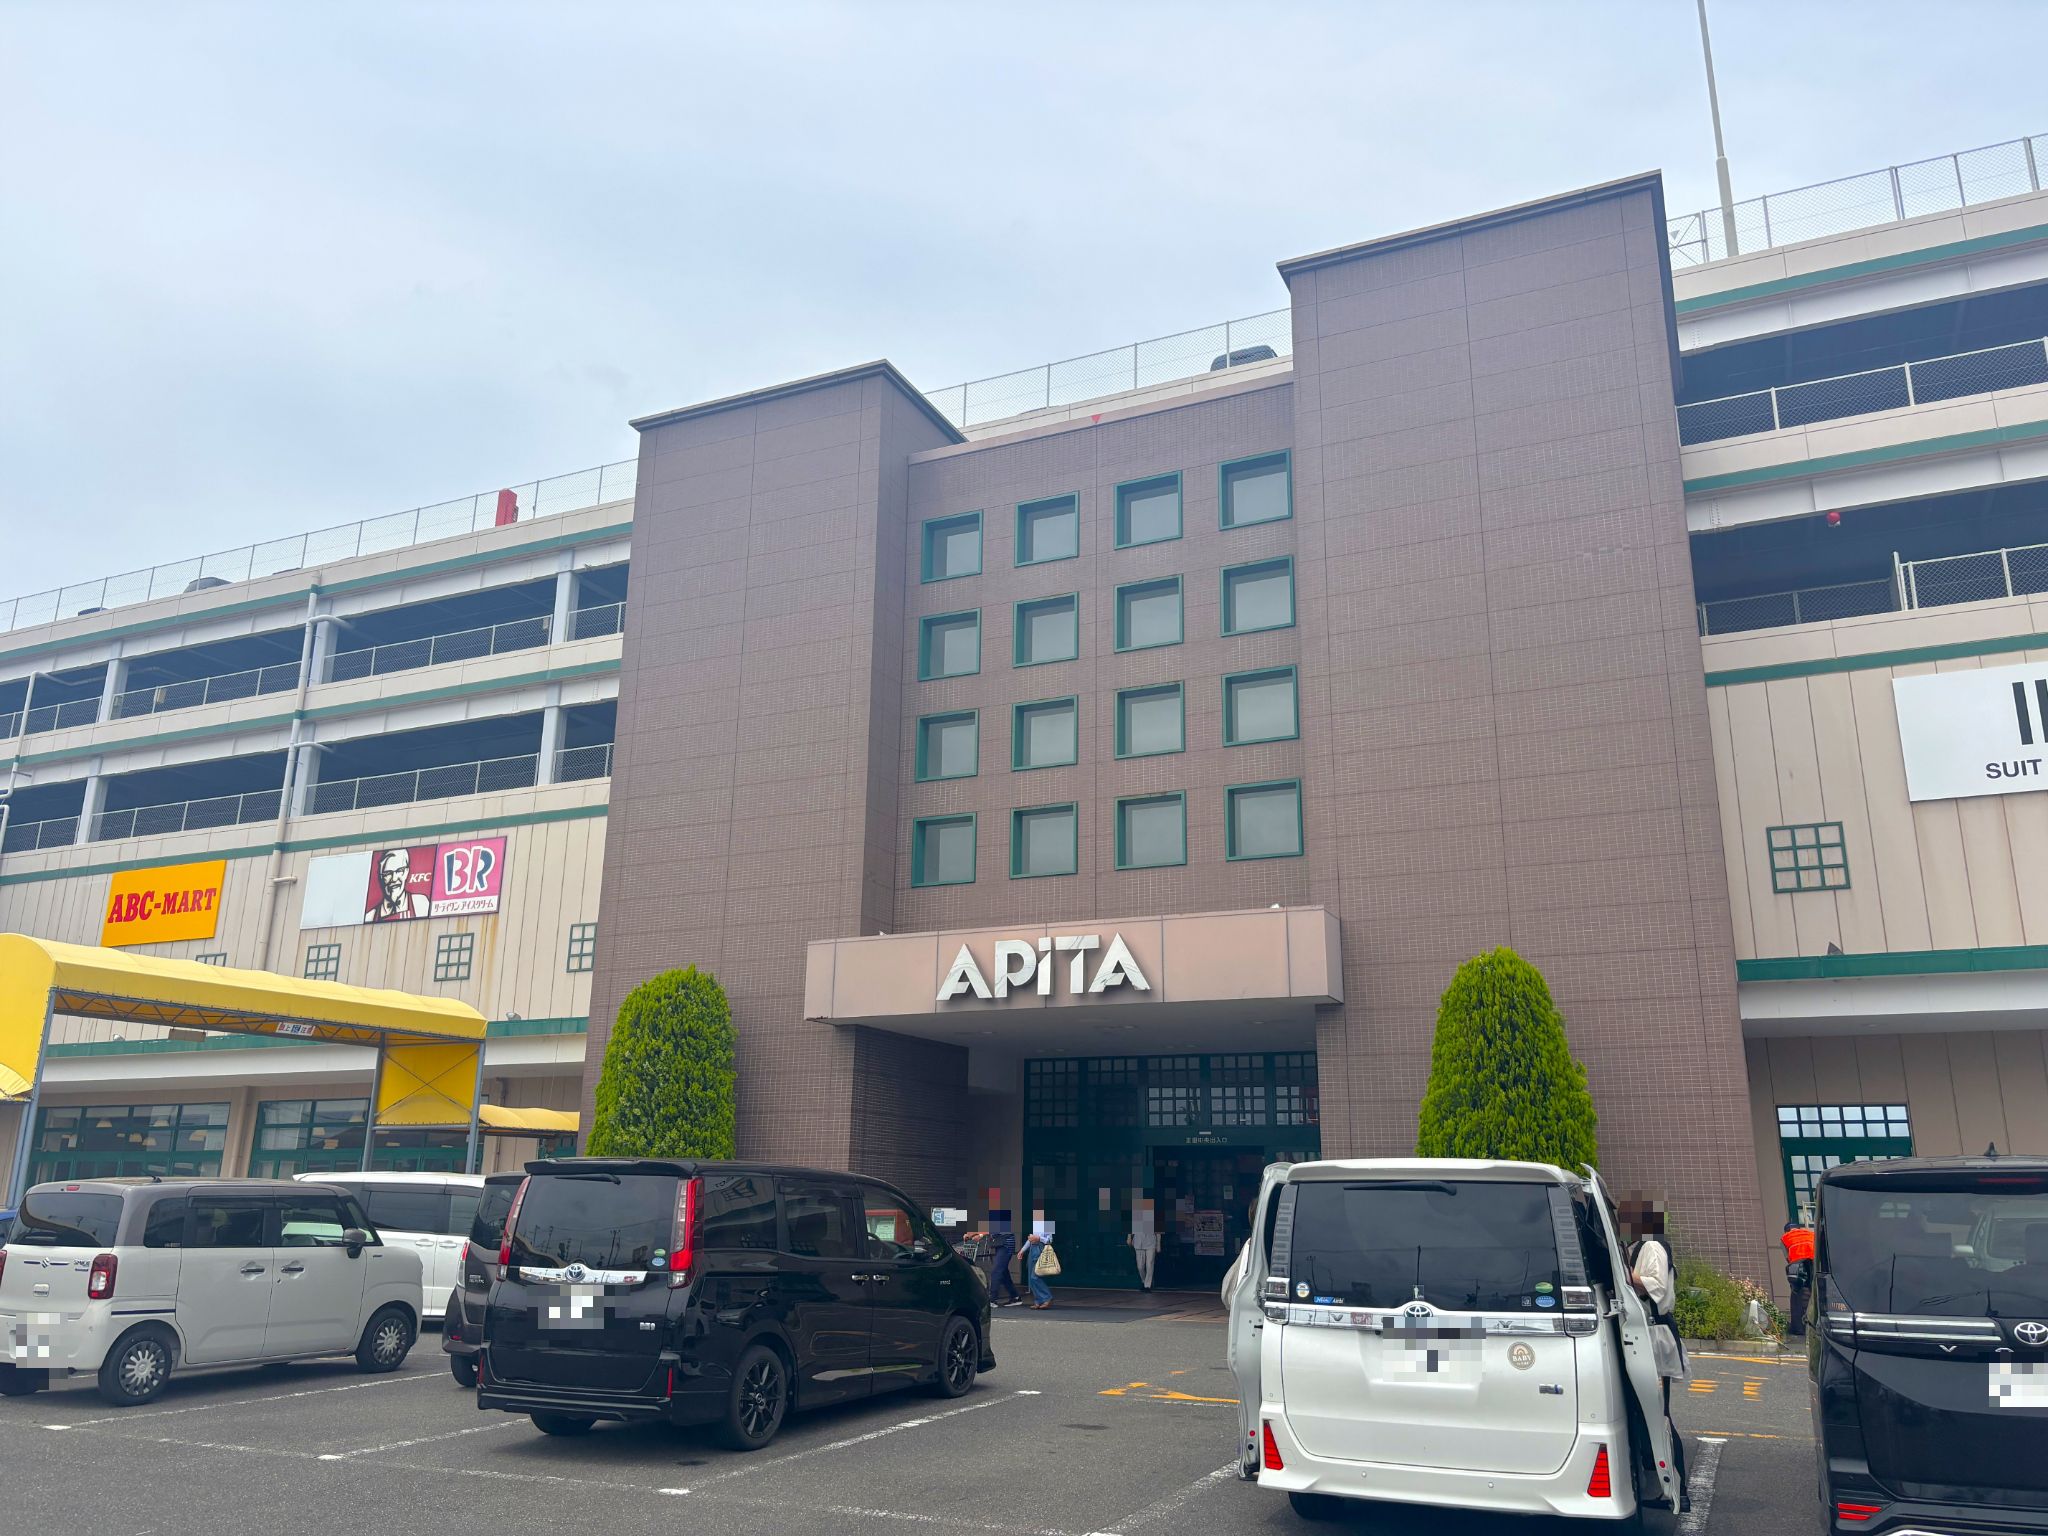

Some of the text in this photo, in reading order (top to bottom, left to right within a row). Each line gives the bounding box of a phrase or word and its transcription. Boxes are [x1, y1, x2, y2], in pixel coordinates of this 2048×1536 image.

[1985, 759, 2042, 779] SUIT
[408, 872, 432, 883] KFC
[444, 846, 495, 895] BR
[107, 887, 217, 923] ABC-MART
[461, 898, 494, 911] アイスクリーム
